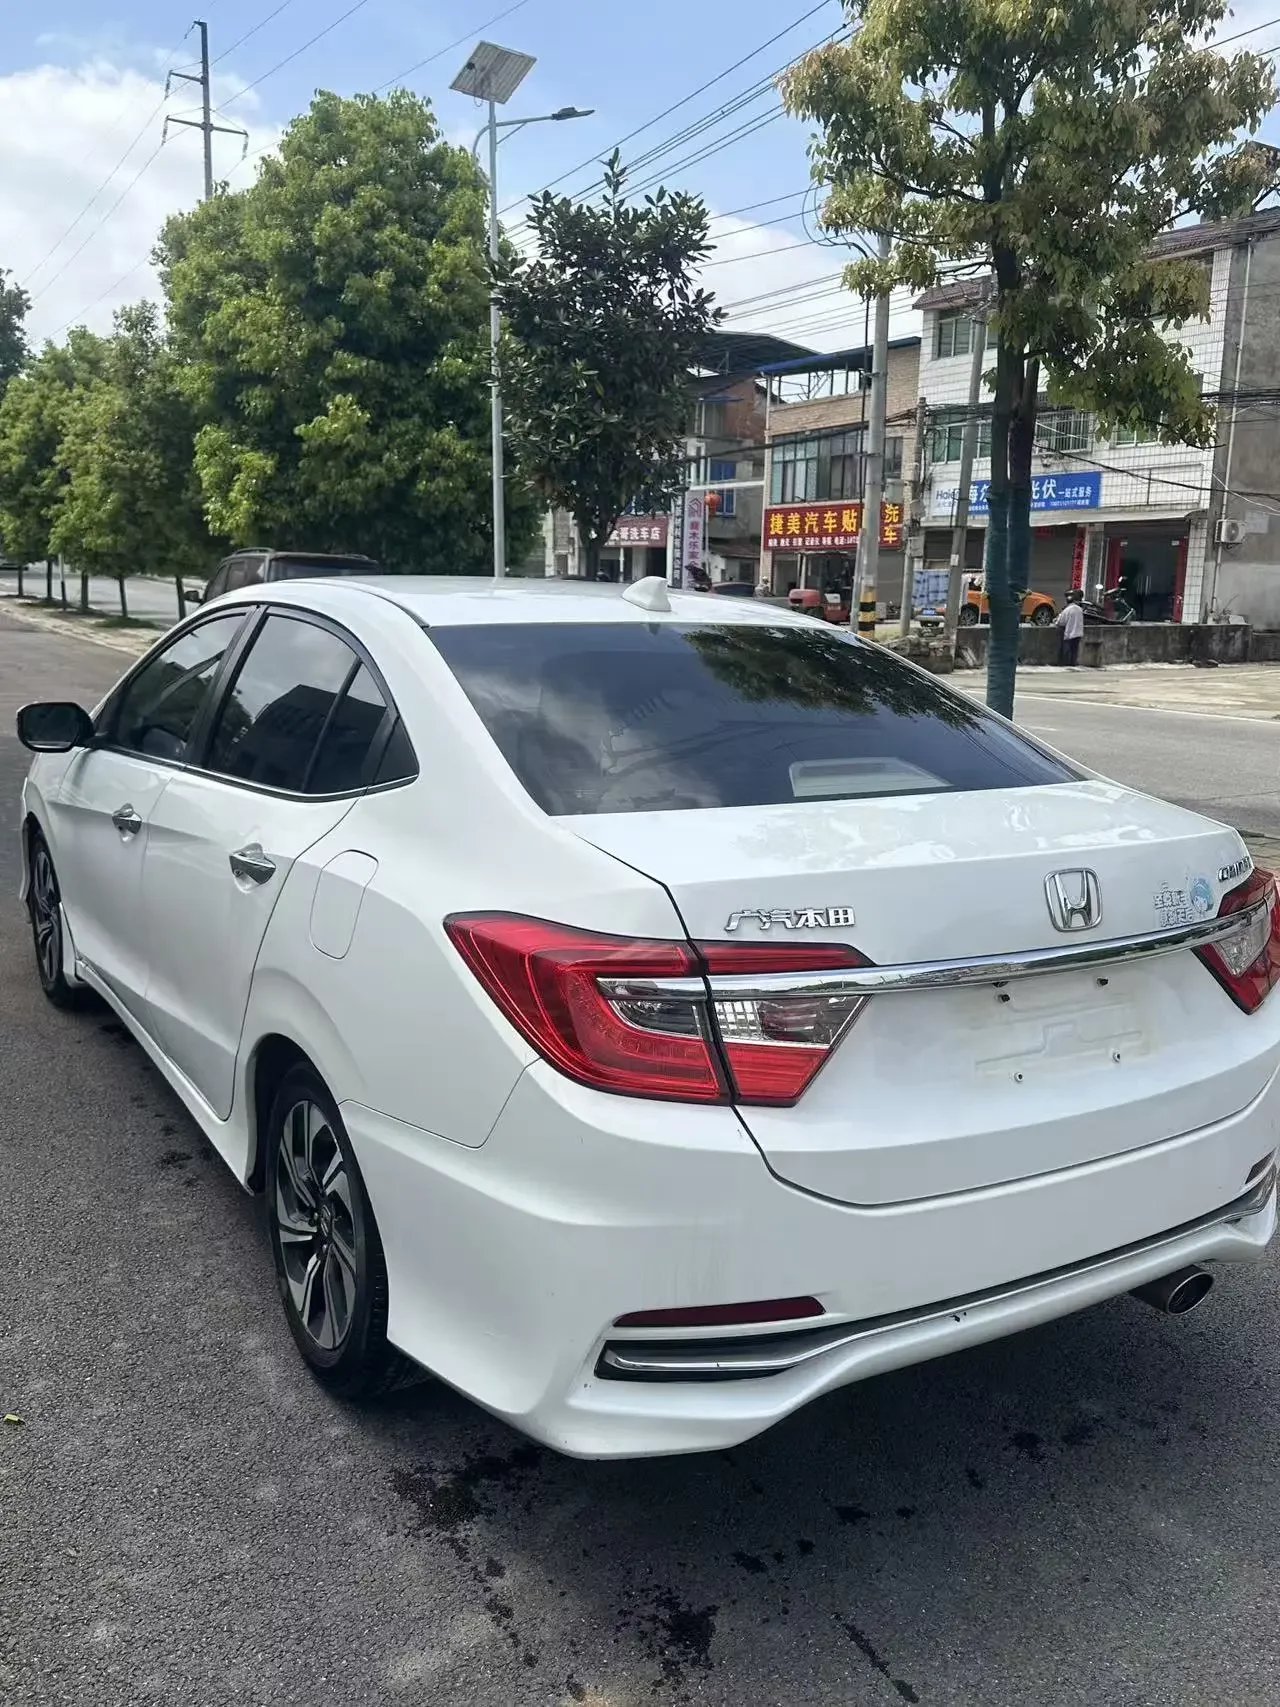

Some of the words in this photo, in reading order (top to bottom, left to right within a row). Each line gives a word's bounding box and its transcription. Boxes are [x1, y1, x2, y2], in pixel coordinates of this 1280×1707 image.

[769, 509, 858, 535] 捷美汽车贴
[884, 503, 899, 543] 洗车
[724, 906, 856, 932] 广汽本田
